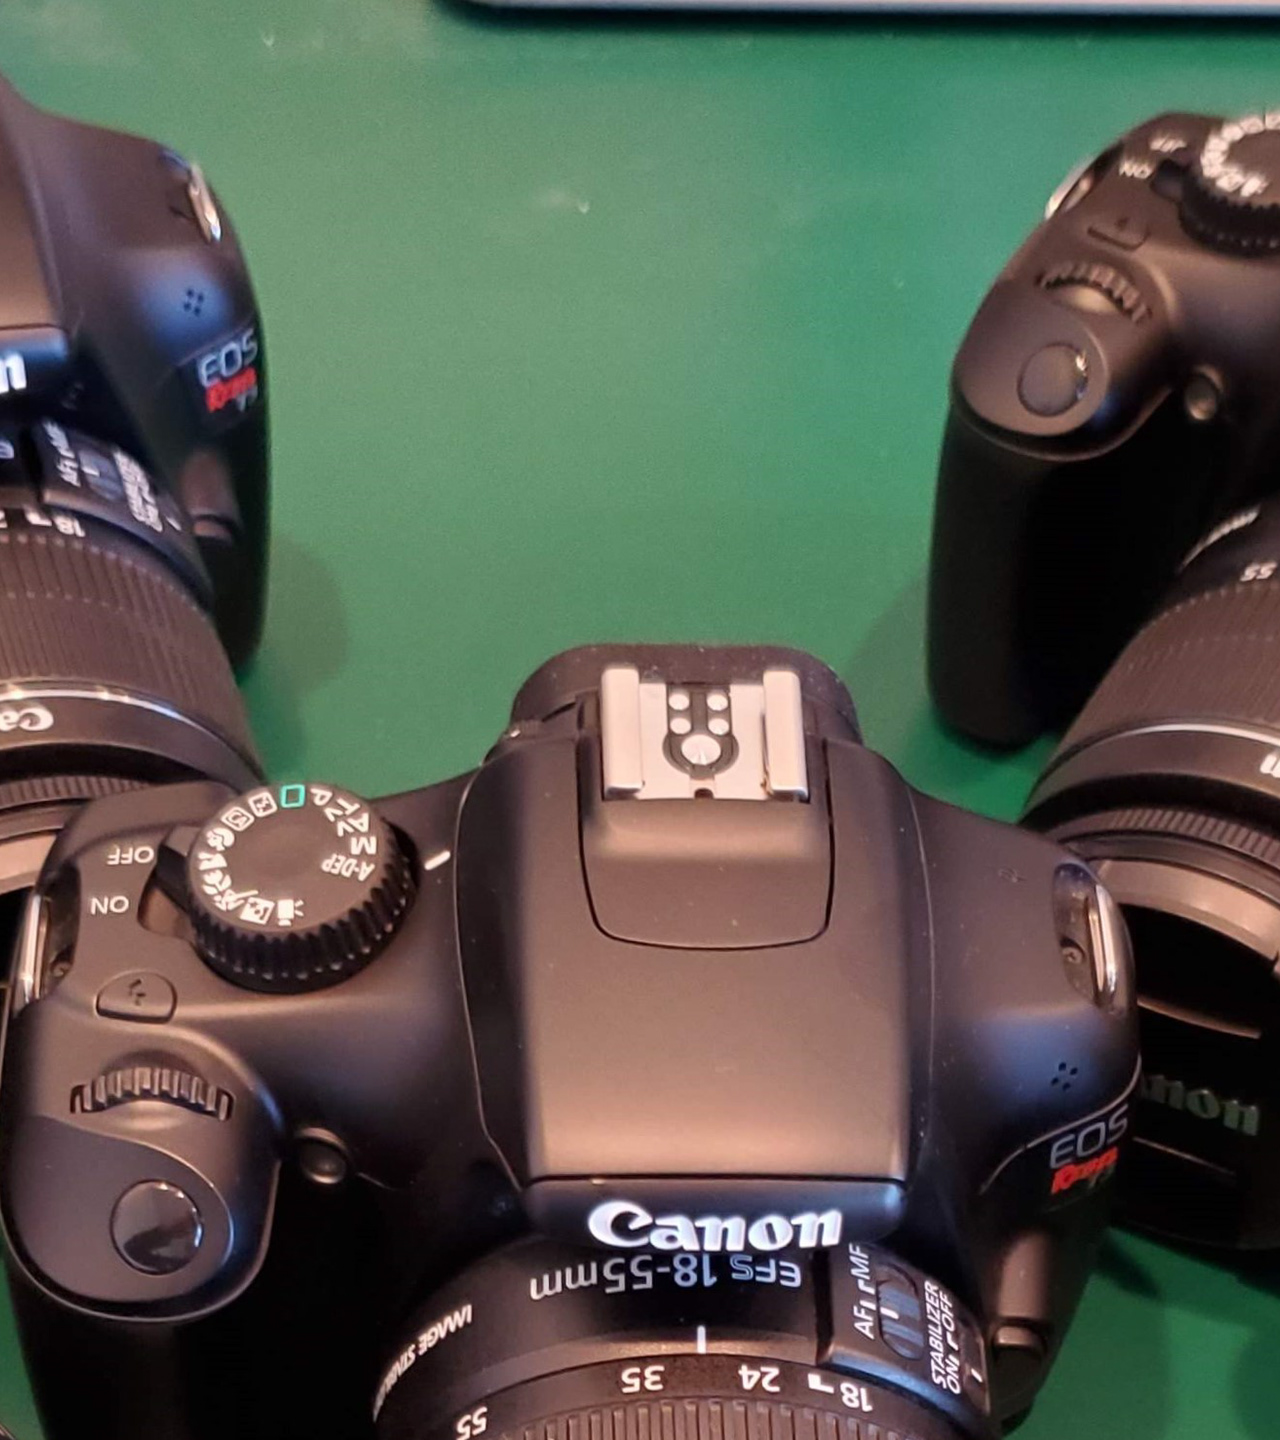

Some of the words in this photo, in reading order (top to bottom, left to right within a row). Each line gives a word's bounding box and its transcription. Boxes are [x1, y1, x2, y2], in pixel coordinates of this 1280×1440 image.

[198, 327, 259, 388] EOS
[1239, 561, 1278, 582] 55
[311, 788, 333, 806] P
[106, 845, 155, 866] OFF
[350, 836, 377, 855] M
[321, 853, 375, 881] A-DEP
[90, 895, 130, 916] ON
[1141, 1074, 1260, 1136] non
[1050, 1104, 1129, 1169] EOS
[587, 1200, 843, 1252] Canon
[530, 1253, 717, 1301] 18-55mm
[730, 1254, 802, 1288] EFS
[848, 1242, 871, 1279] MF
[853, 1305, 876, 1340] AF
[938, 1289, 955, 1332] OFF
[417, 1304, 473, 1356] IMAGE
[924, 1280, 947, 1389] STABILIZER
[620, 1366, 665, 1394] 35
[738, 1364, 781, 1393] 24
[945, 1359, 961, 1395] ON
[840, 1382, 873, 1412] 18
